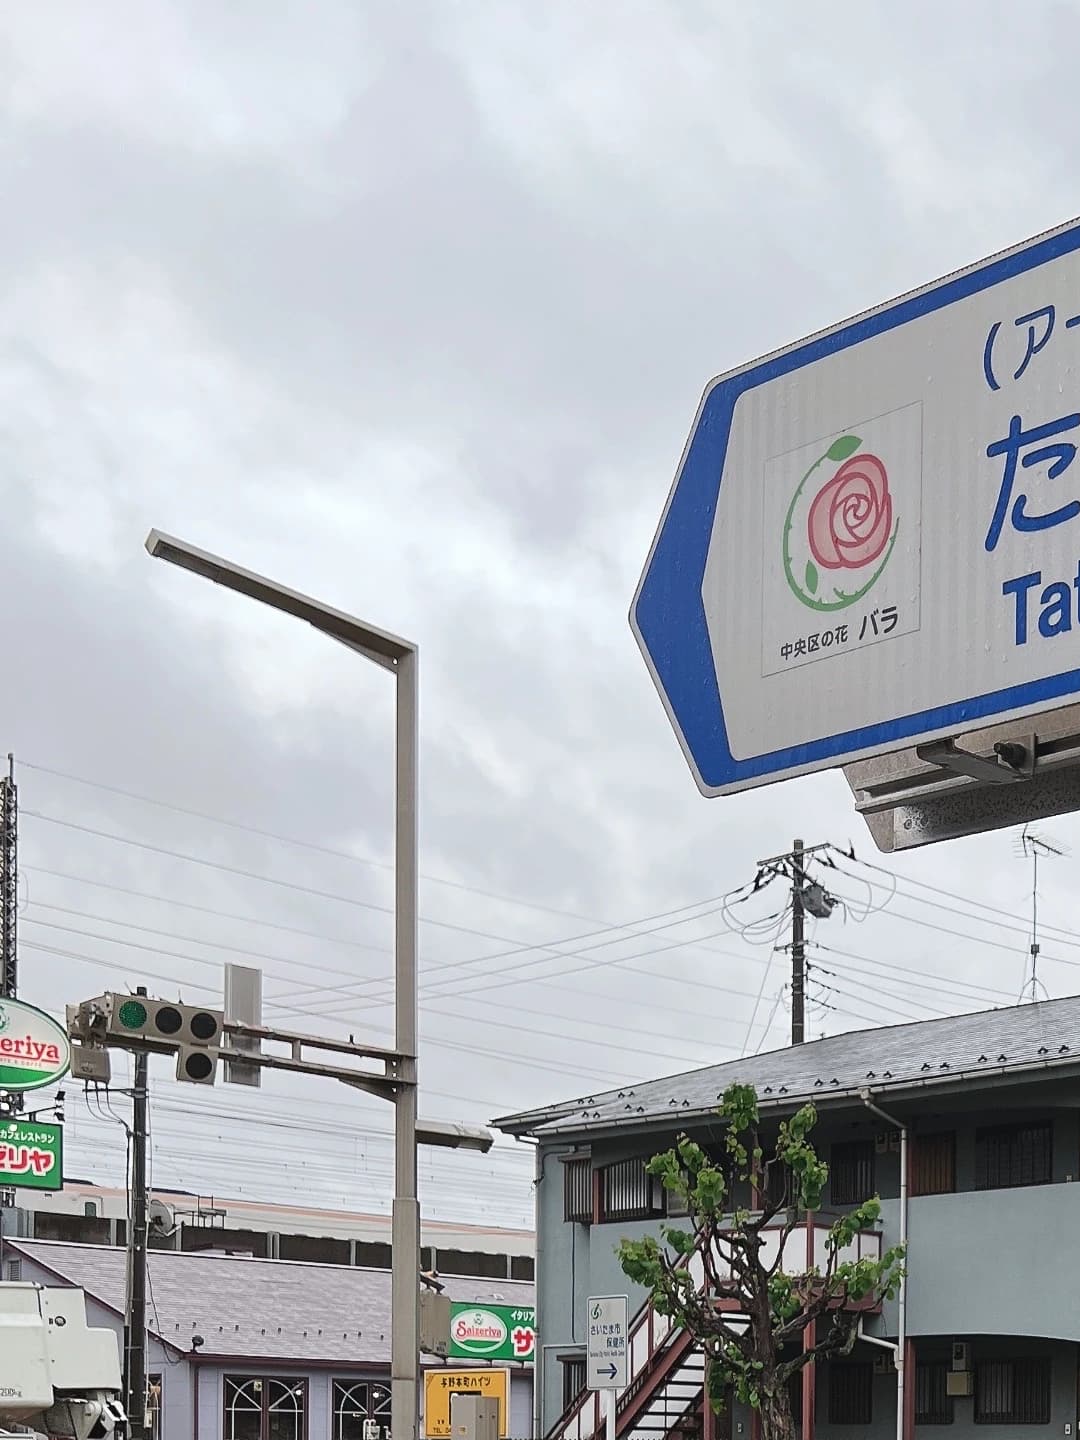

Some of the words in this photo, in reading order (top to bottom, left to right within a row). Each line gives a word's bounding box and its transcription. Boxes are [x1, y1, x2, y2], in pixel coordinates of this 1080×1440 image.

[780, 624, 849, 661] 中央区の花
[858, 605, 899, 641] バラ
[512, 1327, 535, 1355] サ
[590, 1323, 621, 1336] さいたま市
